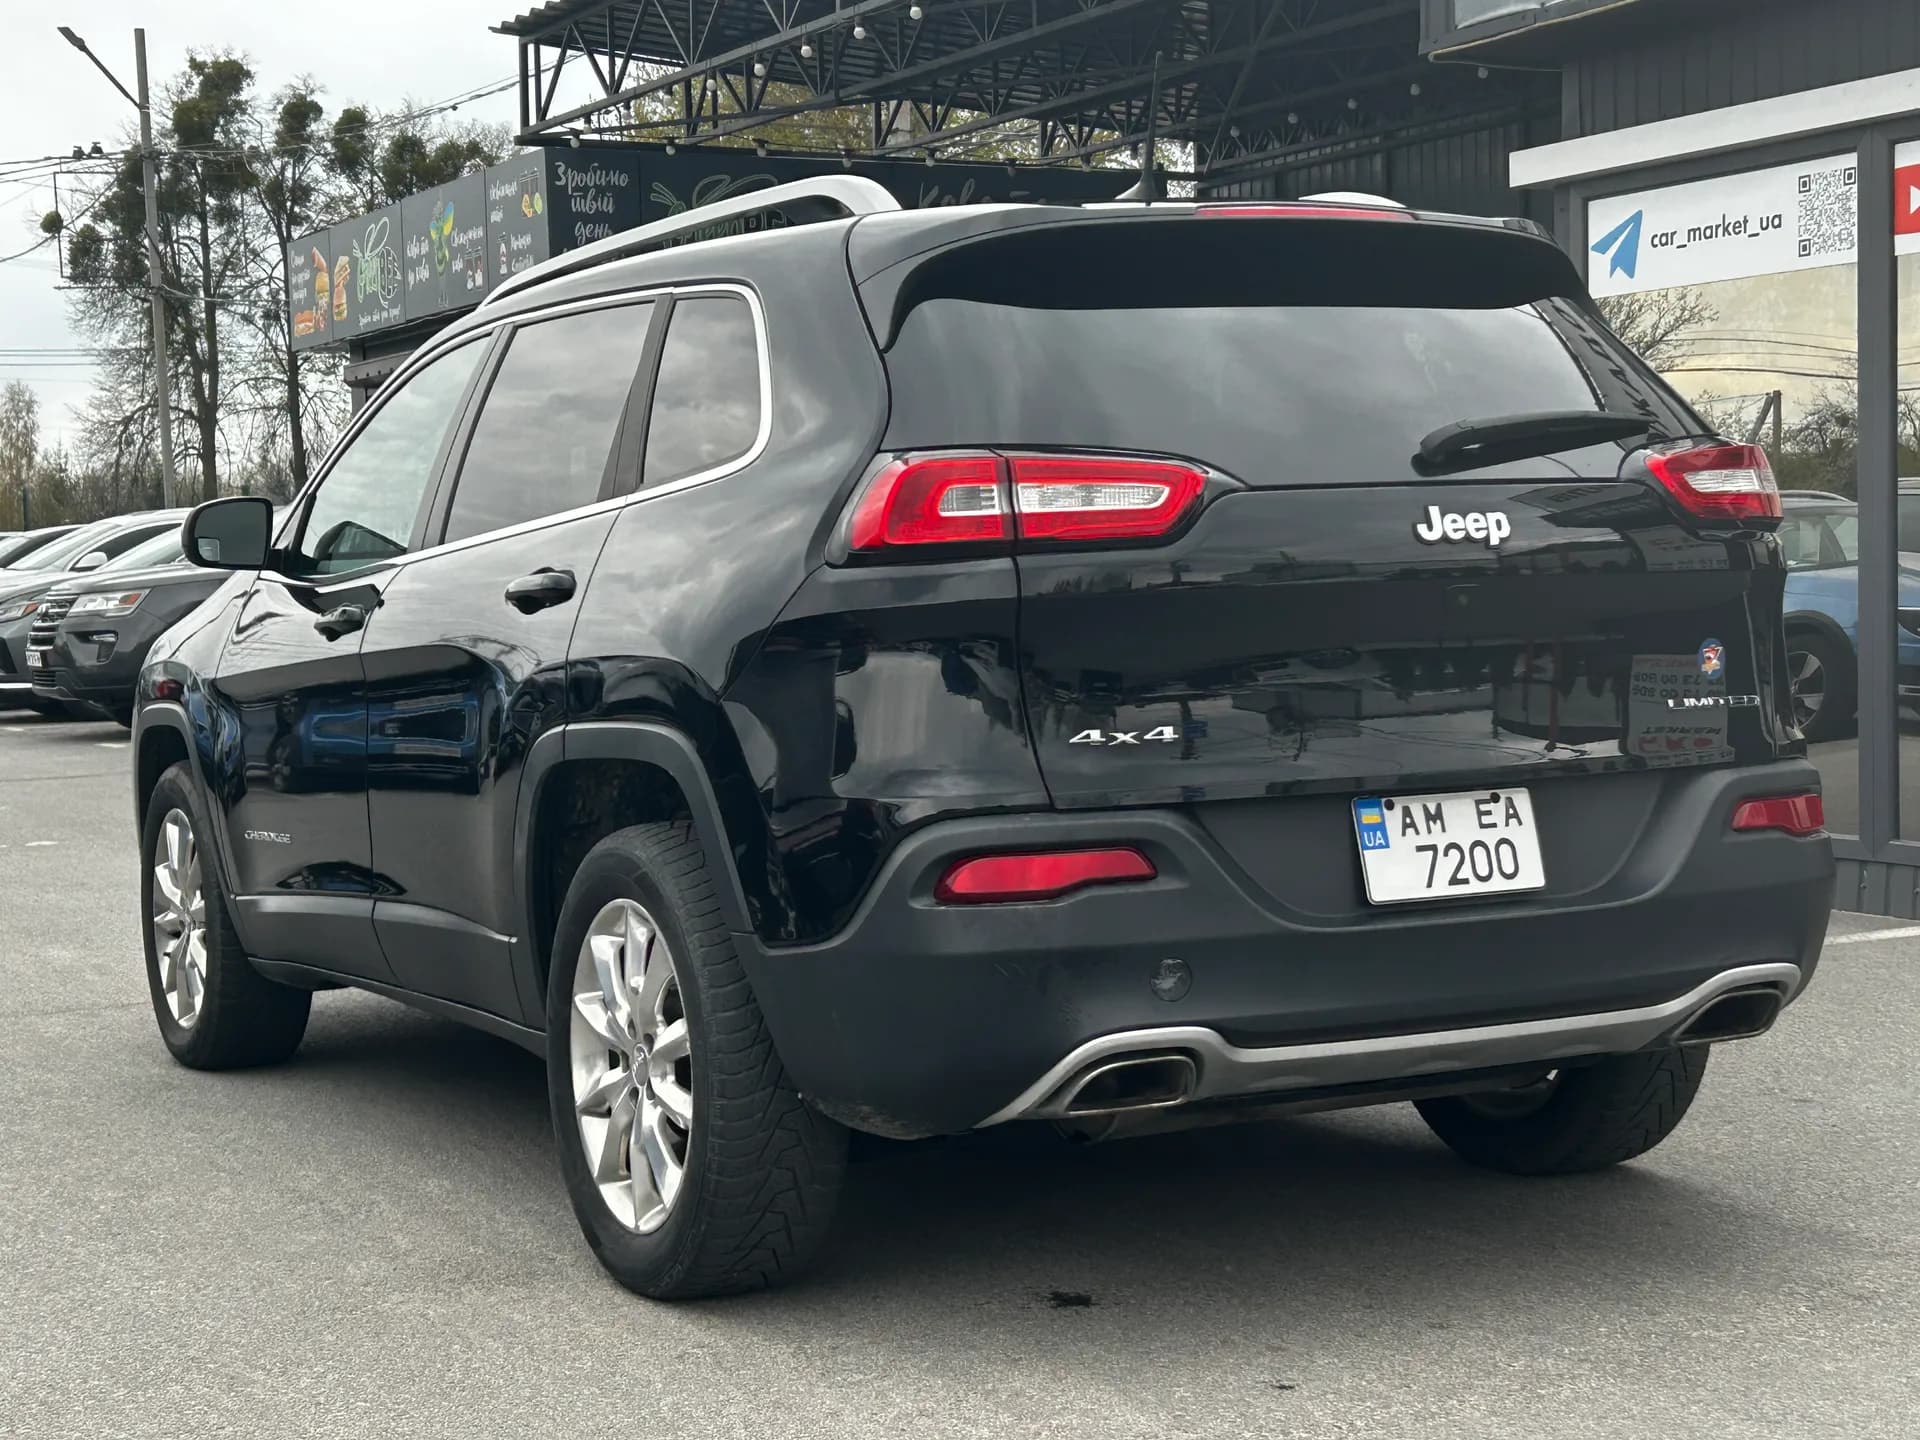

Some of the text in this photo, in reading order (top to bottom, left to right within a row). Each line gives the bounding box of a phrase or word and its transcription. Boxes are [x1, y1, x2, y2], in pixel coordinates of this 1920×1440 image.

[554, 161, 630, 195] Зробимо
[571, 192, 615, 214] твій
[1650, 213, 1783, 249] car_market_ua
[1416, 505, 1511, 545] Jeep
[1667, 695, 1759, 709] LIMITED
[1069, 726, 1179, 745] 4x4
[1401, 796, 1523, 837] AM EA
[1363, 831, 1386, 847] UA
[1415, 837, 1520, 888] 7200
